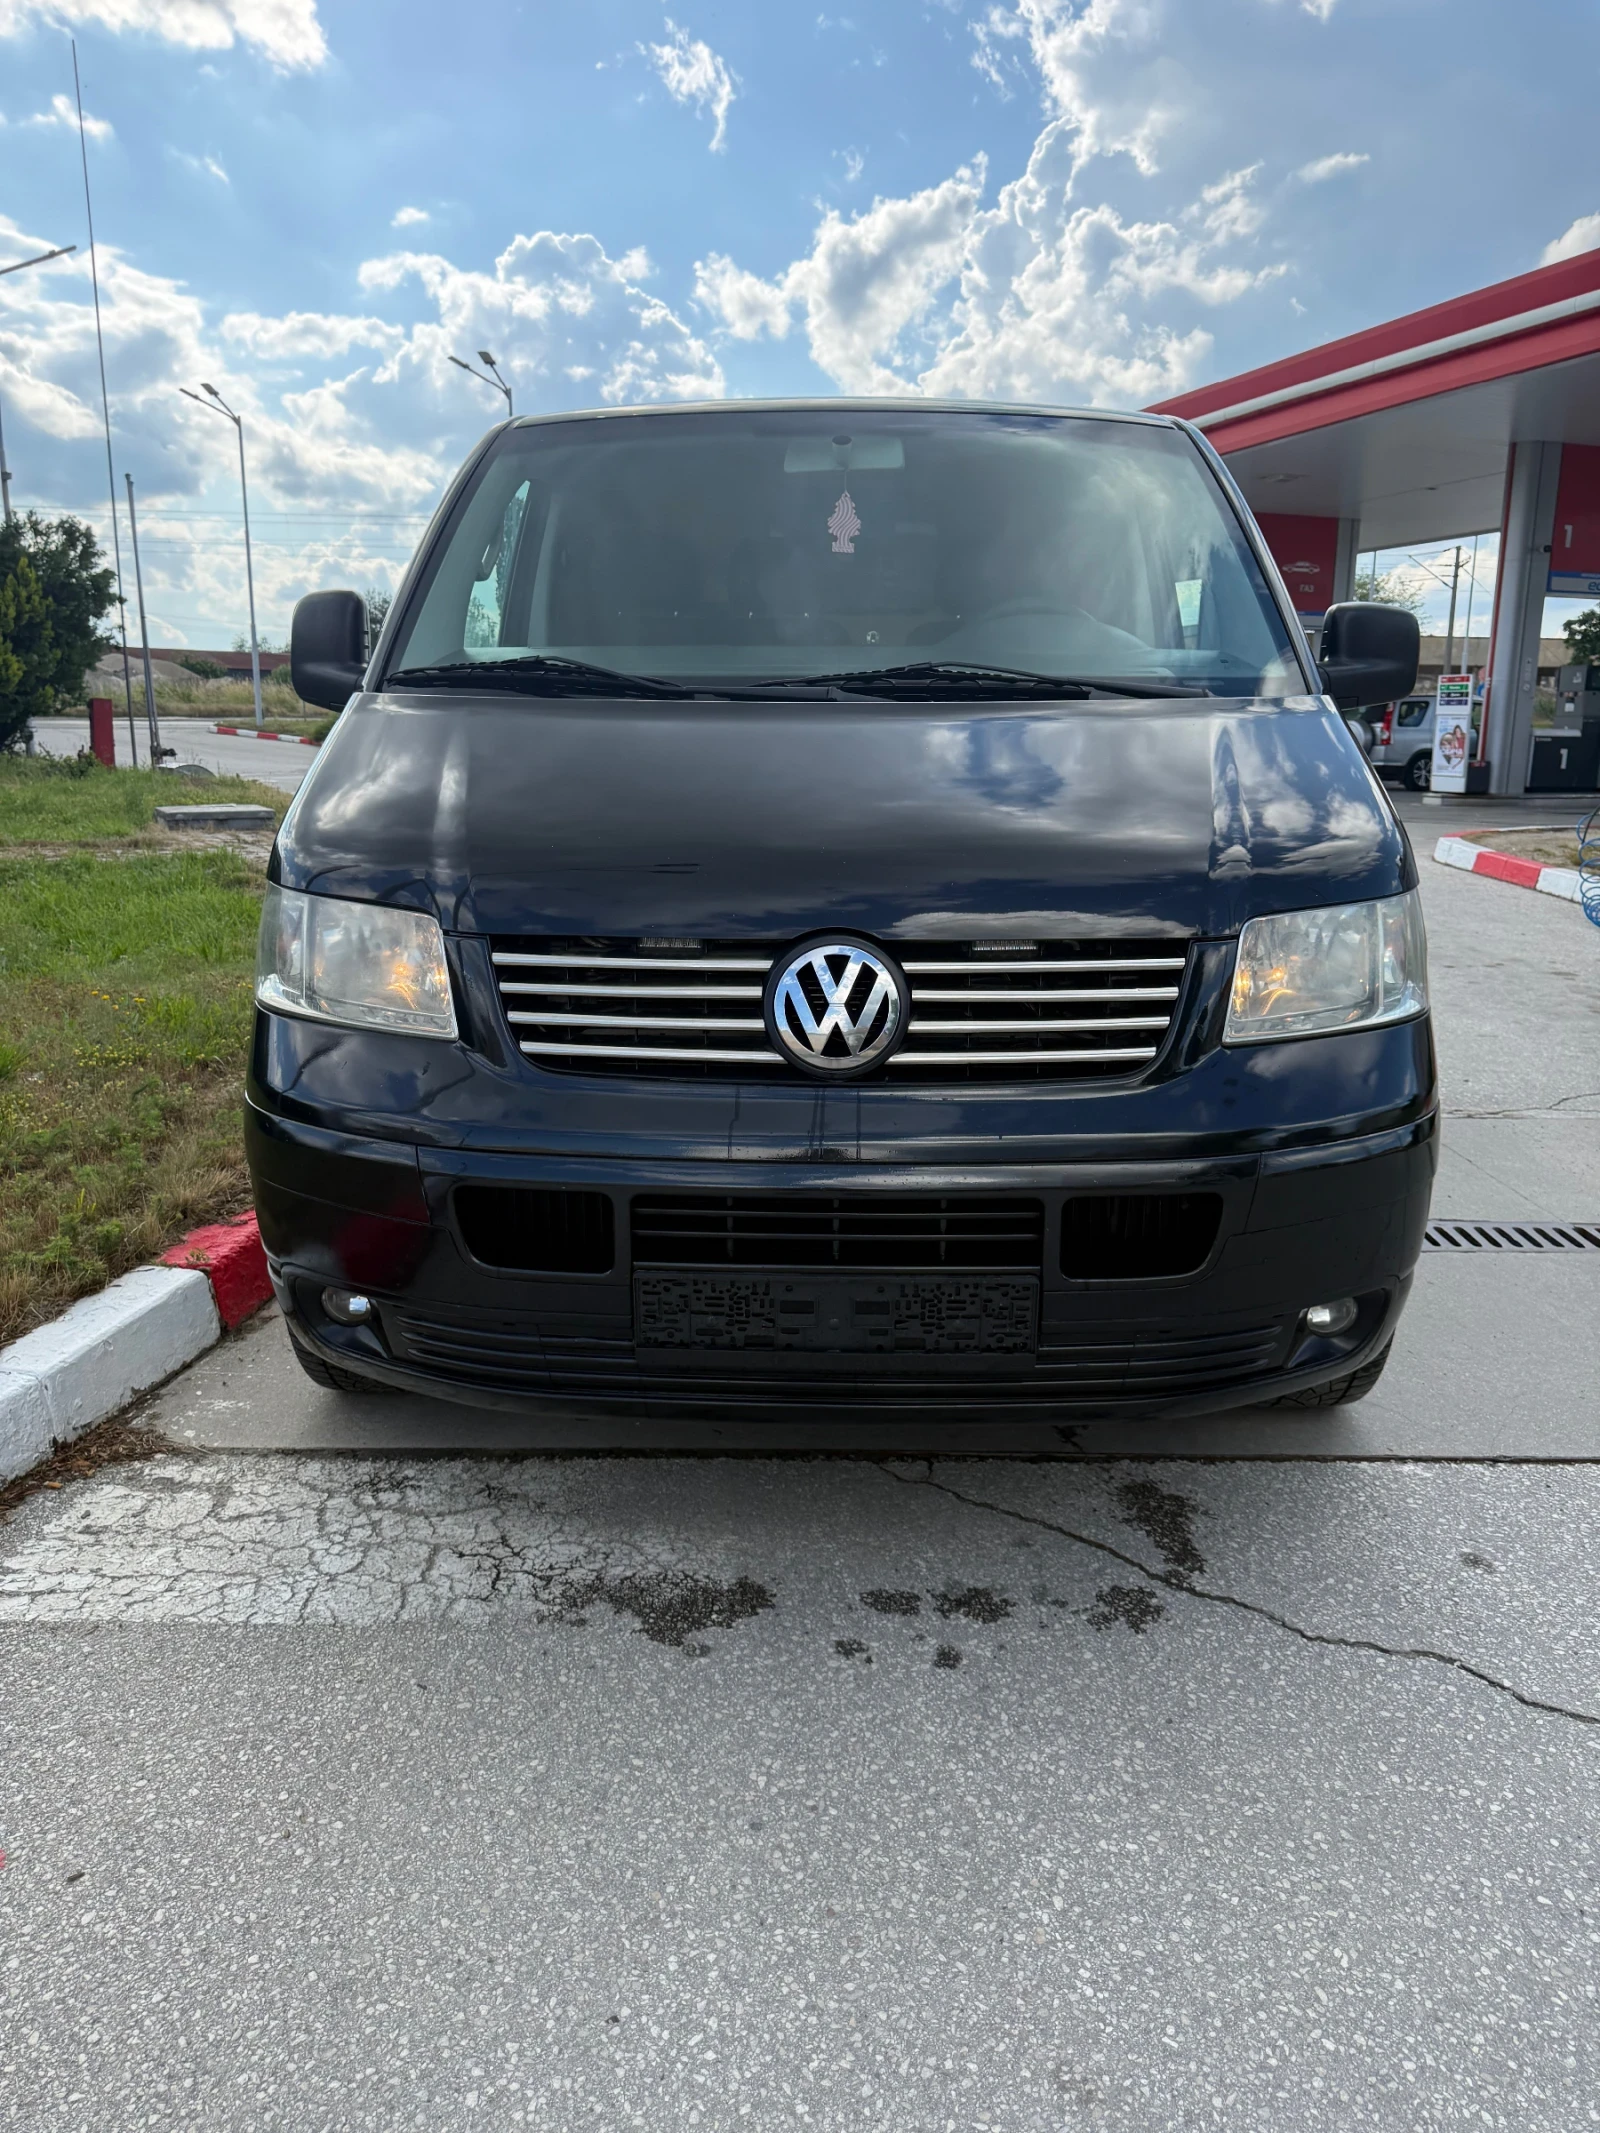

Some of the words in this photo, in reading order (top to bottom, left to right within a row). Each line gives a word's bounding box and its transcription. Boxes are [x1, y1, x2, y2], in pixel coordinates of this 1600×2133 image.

[1564, 524, 1573, 548] 1
[1560, 748, 1568, 769] 1
[778, 948, 896, 1065] VW
